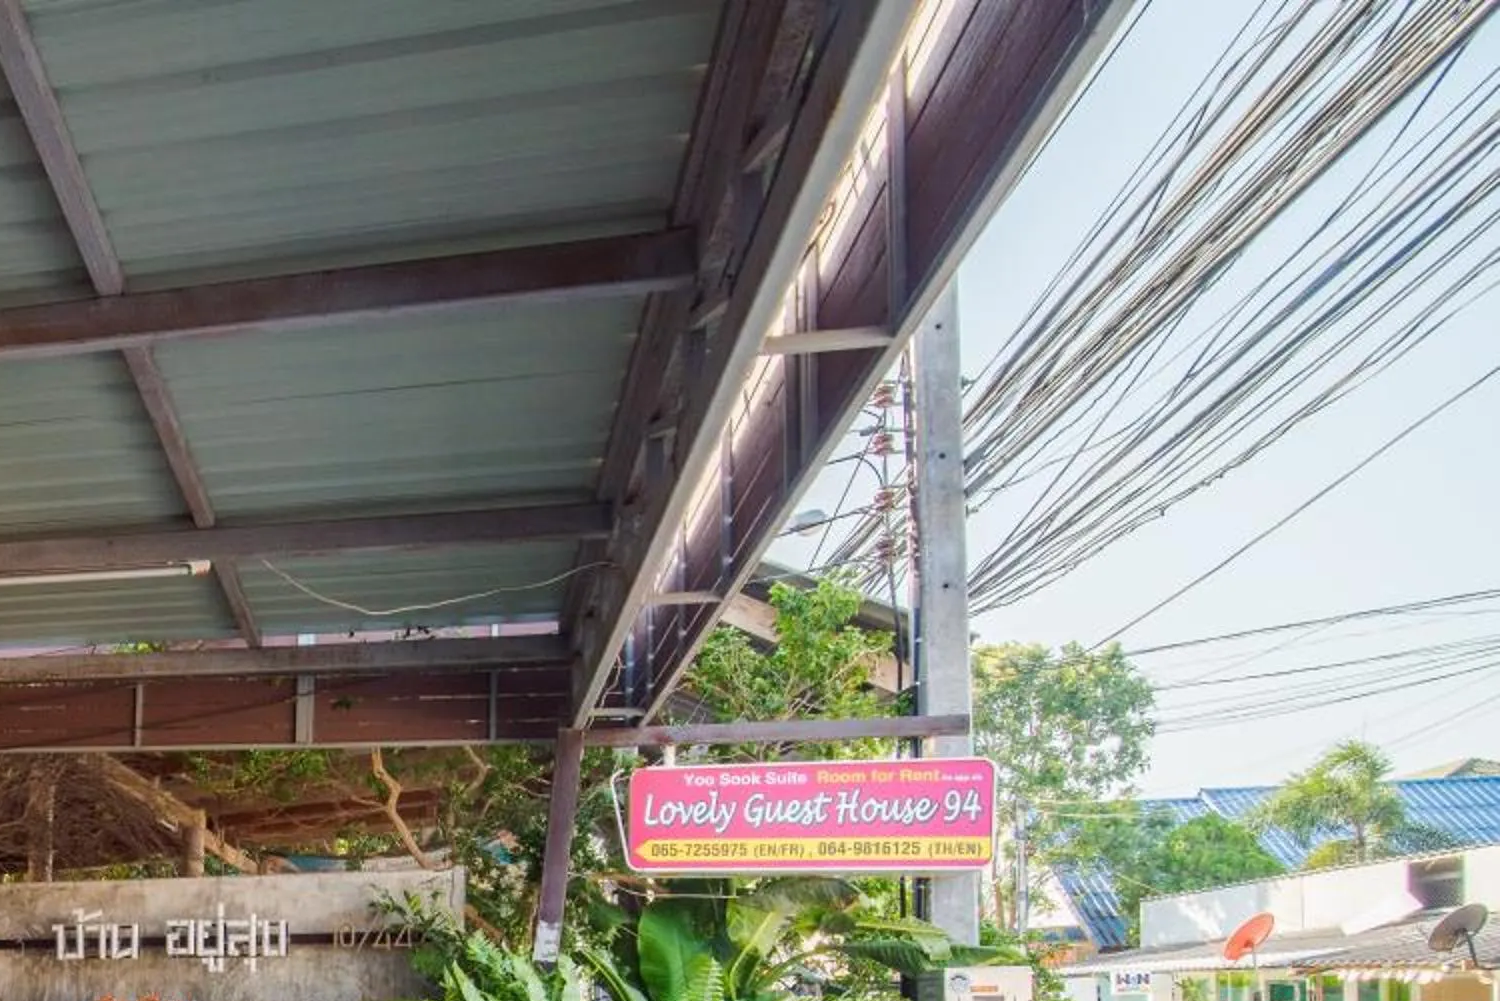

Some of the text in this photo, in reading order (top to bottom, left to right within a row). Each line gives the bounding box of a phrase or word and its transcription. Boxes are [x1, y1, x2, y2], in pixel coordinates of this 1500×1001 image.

[765, 771, 808, 785] Suite
[816, 769, 866, 784] Room
[871, 769, 896, 783] for
[899, 768, 940, 783] Rent
[644, 788, 982, 833] Lovely Guest House 94
[650, 843, 748, 858] 065-7255975
[51, 907, 140, 961] บ้าน
